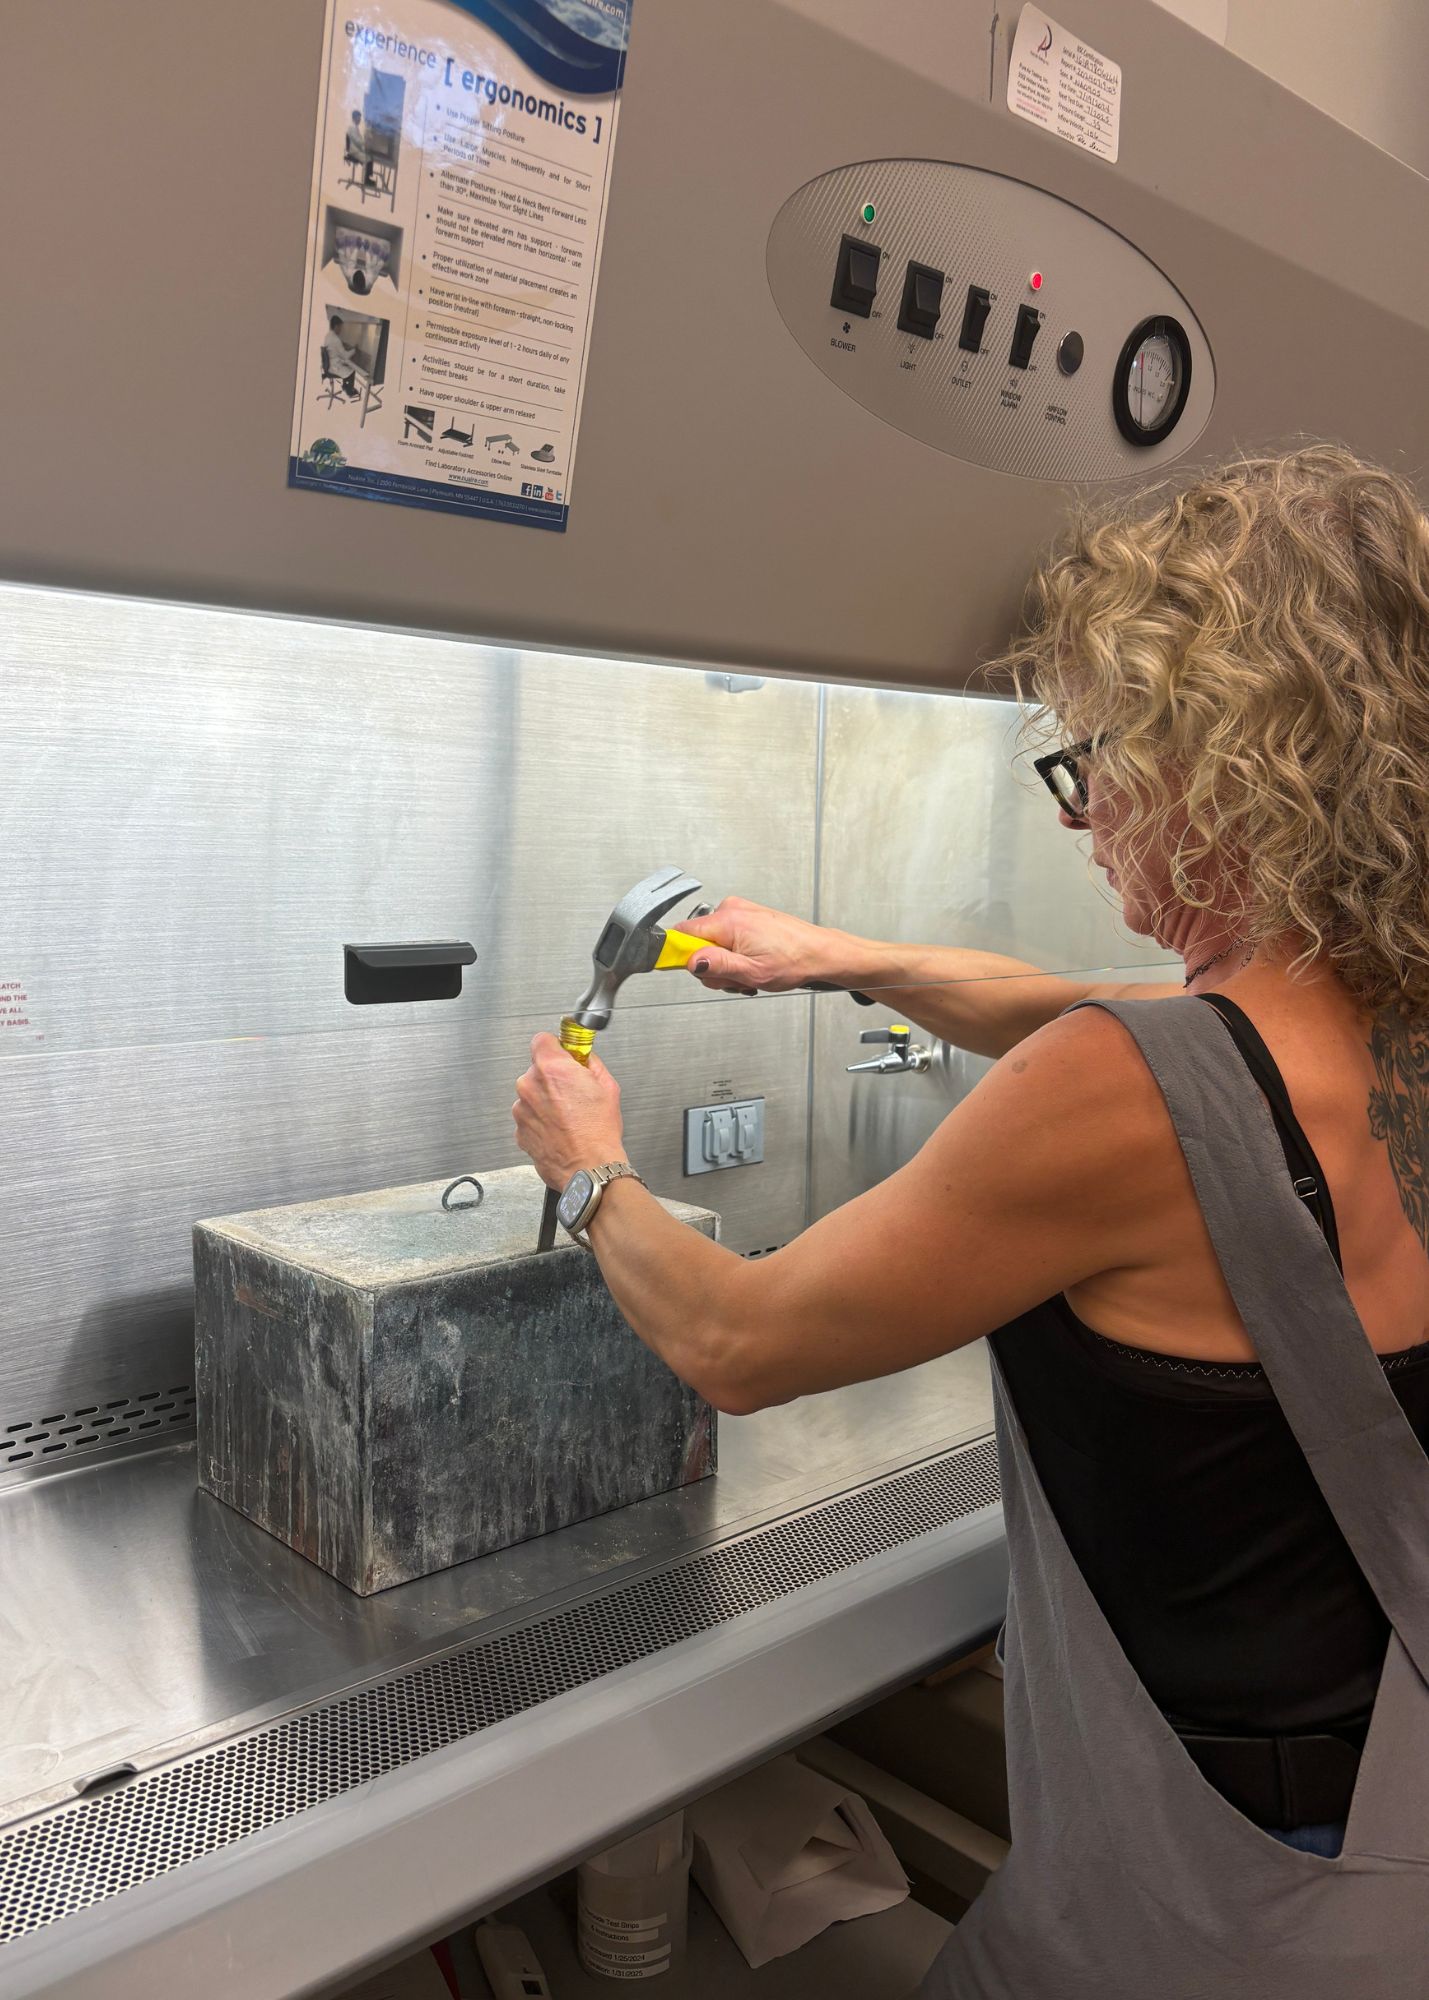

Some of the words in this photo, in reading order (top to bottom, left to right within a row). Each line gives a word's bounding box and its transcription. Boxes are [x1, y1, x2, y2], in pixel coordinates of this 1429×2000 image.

[345, 20, 437, 68] experience
[462, 69, 587, 134] ergonomics
[481, 121, 501, 136] Sitting
[502, 128, 525, 143] Posture
[443, 144, 466, 159] Periods
[475, 156, 489, 167] Time
[510, 157, 545, 177] Infrequently
[548, 171, 559, 181] and
[563, 176, 571, 185] for
[575, 180, 590, 192] Short
[439, 181, 454, 191] than
[469, 191, 496, 205] Maximize
[498, 200, 511, 210] Your
[512, 205, 527, 217] Sight
[528, 210, 543, 221] Lines
[440, 169, 469, 186] Alternate
[470, 179, 496, 195] Postures
[500, 190, 516, 201] Head
[522, 197, 536, 208] Neck
[537, 202, 550, 213] Bent
[551, 207, 573, 221] Forward
[574, 215, 586, 225] Less
[435, 227, 459, 240] forearm
[460, 235, 483, 248] support
[436, 217, 456, 229] should
[458, 224, 468, 233] not
[480, 230, 505, 244] elevated
[506, 239, 521, 249] more
[523, 244, 536, 254] than
[538, 249, 566, 263] horizontal
[571, 259, 581, 268] use
[437, 205, 453, 217] Make
[457, 212, 470, 222] sure
[473, 217, 498, 231] elevated
[501, 226, 513, 236] arm
[516, 231, 527, 240] has
[530, 235, 552, 249] support
[561, 245, 582, 258] forearm
[431, 262, 458, 275] effective
[459, 270, 474, 280] work
[475, 274, 489, 284] zone
[433, 251, 453, 264] Proper
[455, 258, 484, 272] utilization
[494, 269, 517, 282] material
[519, 277, 547, 291] placement
[549, 286, 569, 297] creates
[428, 296, 452, 310] position
[429, 286, 445, 296] Have
[446, 291, 460, 300] wrist
[461, 295, 479, 305] in-line
[480, 300, 492, 309] with
[493, 304, 515, 316] forearm
[425, 331, 457, 344] continuous
[458, 339, 480, 352] activity
[426, 320, 460, 335] Permissible
[461, 329, 487, 343] exposure
[488, 336, 502, 346] level
[522, 345, 538, 355] hours
[538, 349, 551, 359] daily
[559, 355, 569, 364] any
[830, 338, 856, 352] BLOWER
[421, 364, 447, 376] frequent
[448, 371, 467, 380] breaks
[422, 354, 450, 366] Activities
[454, 362, 473, 372] should
[508, 375, 522, 384] short
[554, 386, 565, 394] take
[900, 361, 916, 371] LIGHT
[951, 377, 971, 388] OUTLET
[419, 388, 434, 396] Have
[435, 391, 453, 402] upper
[454, 395, 478, 406] shoulder
[485, 403, 501, 412] upper
[502, 406, 514, 414] arm
[515, 409, 535, 419] relaxed
[1000, 400, 1018, 409] ALARM
[1001, 390, 1021, 401] WINDOW
[437, 462, 466, 472] Laboratory
[467, 467, 495, 478] Accessories
[496, 473, 512, 481] Online
